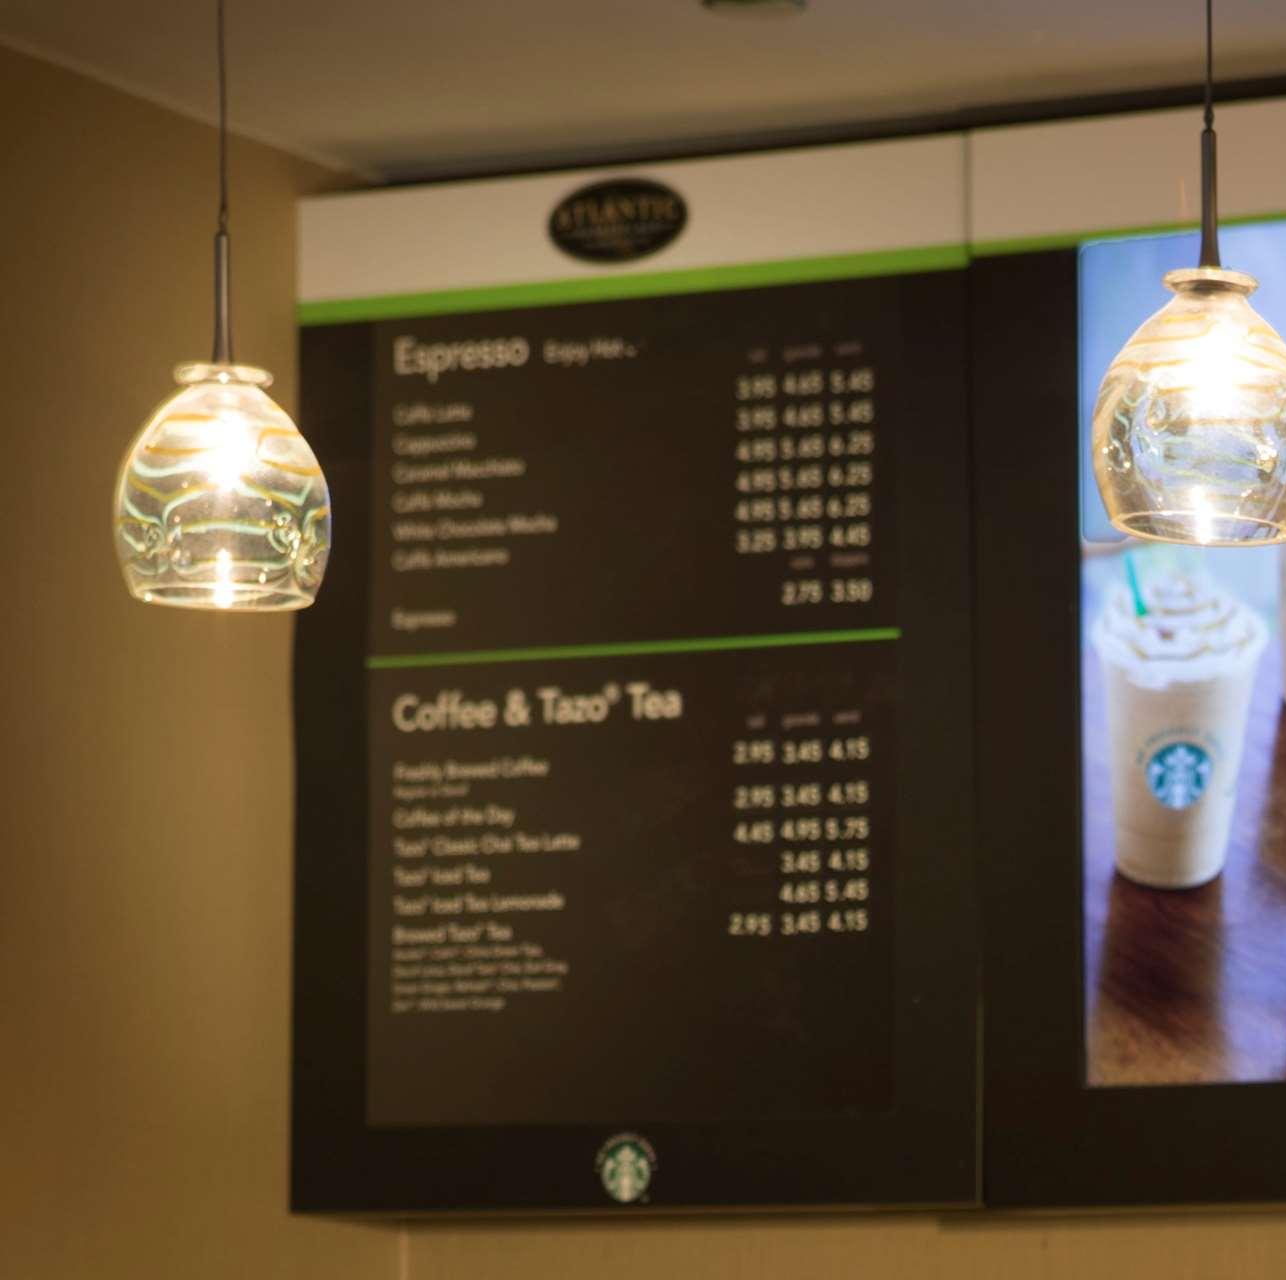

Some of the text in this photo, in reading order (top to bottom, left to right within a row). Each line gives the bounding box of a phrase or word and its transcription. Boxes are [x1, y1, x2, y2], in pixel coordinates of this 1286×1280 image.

[394, 336, 530, 384] Espresso
[392, 688, 498, 732] Coffee
[503, 687, 531, 727] &
[624, 681, 683, 720] Tea
[729, 911, 771, 937] 2.95
